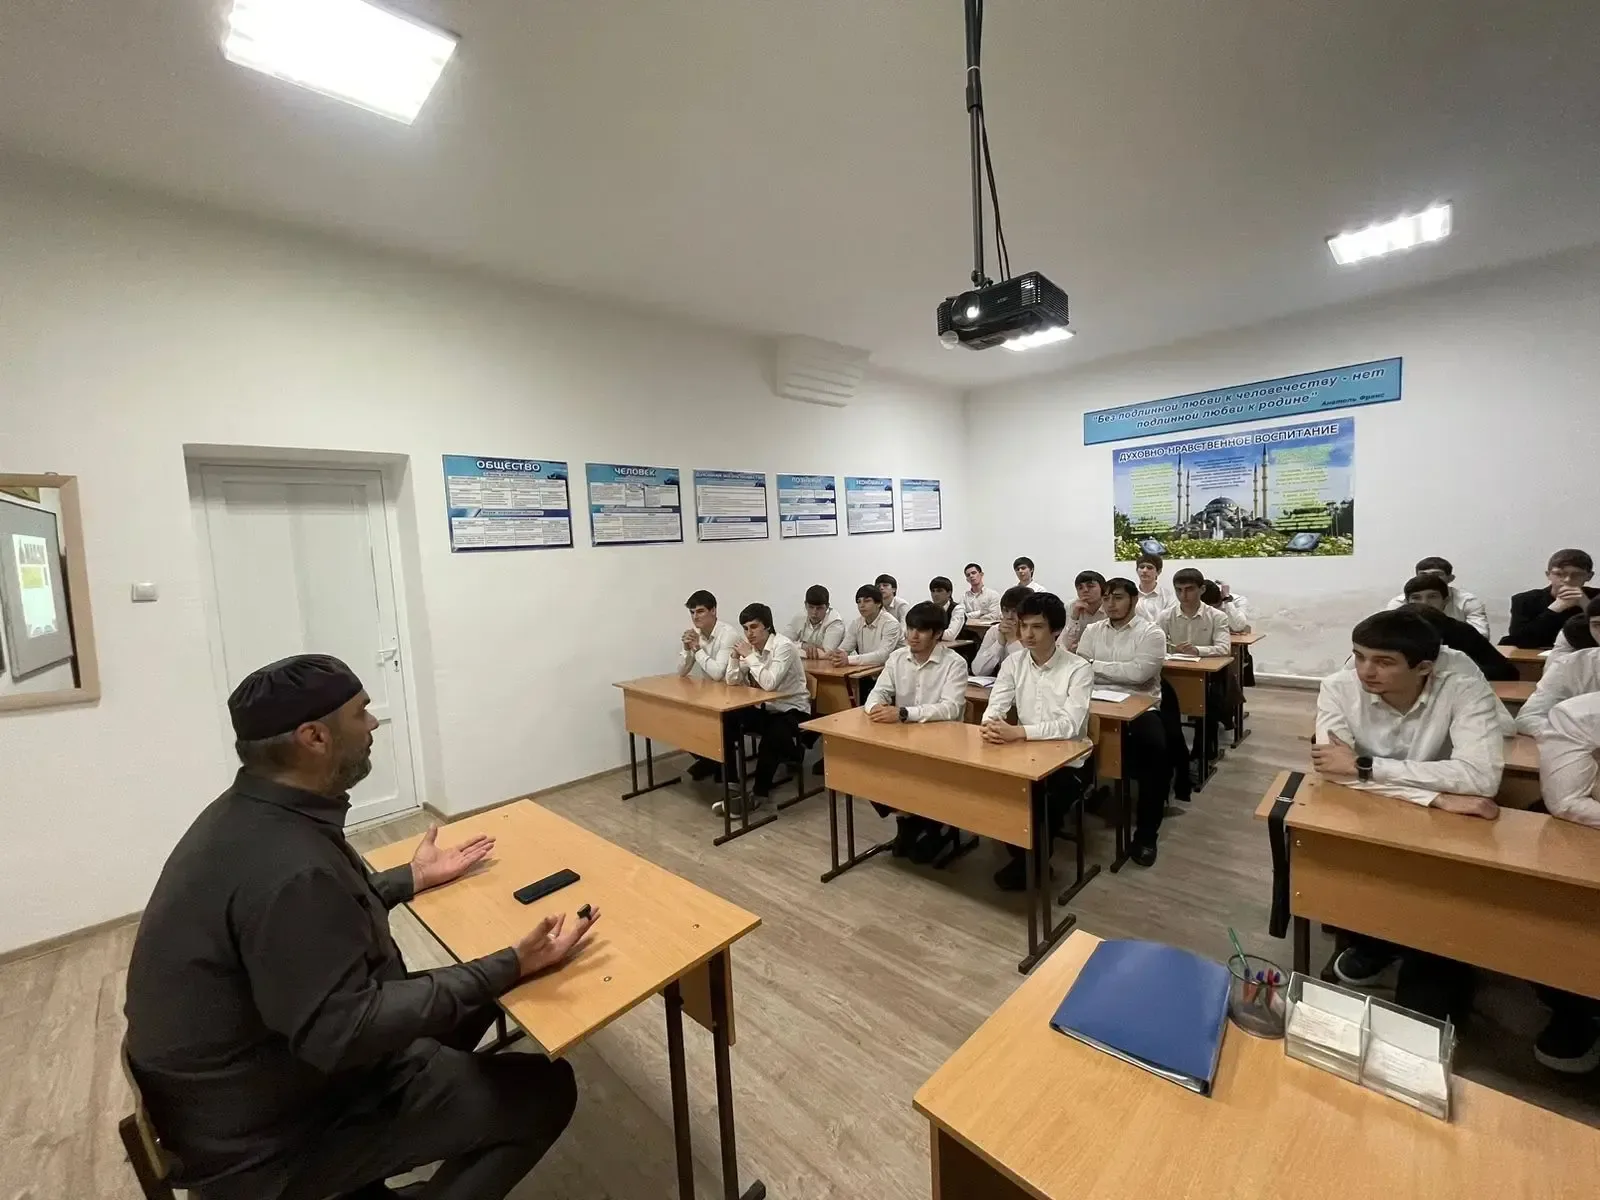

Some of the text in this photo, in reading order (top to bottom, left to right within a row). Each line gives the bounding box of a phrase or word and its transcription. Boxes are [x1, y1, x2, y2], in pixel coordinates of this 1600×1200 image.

[1118, 403, 1179, 420] подлинной
[1181, 396, 1222, 409] любви
[1225, 394, 1232, 402] к
[1236, 376, 1338, 400] человечеству
[1352, 367, 1385, 381] нет
[1136, 411, 1199, 429] подлинной
[1202, 404, 1244, 418] любви
[1248, 403, 1255, 411] к
[1254, 424, 1339, 443] ВОСПИТАНИЕ
[476, 459, 541, 472] ОБЩЕСТВО
[613, 467, 657, 477] ЧЕЛОВЕК
